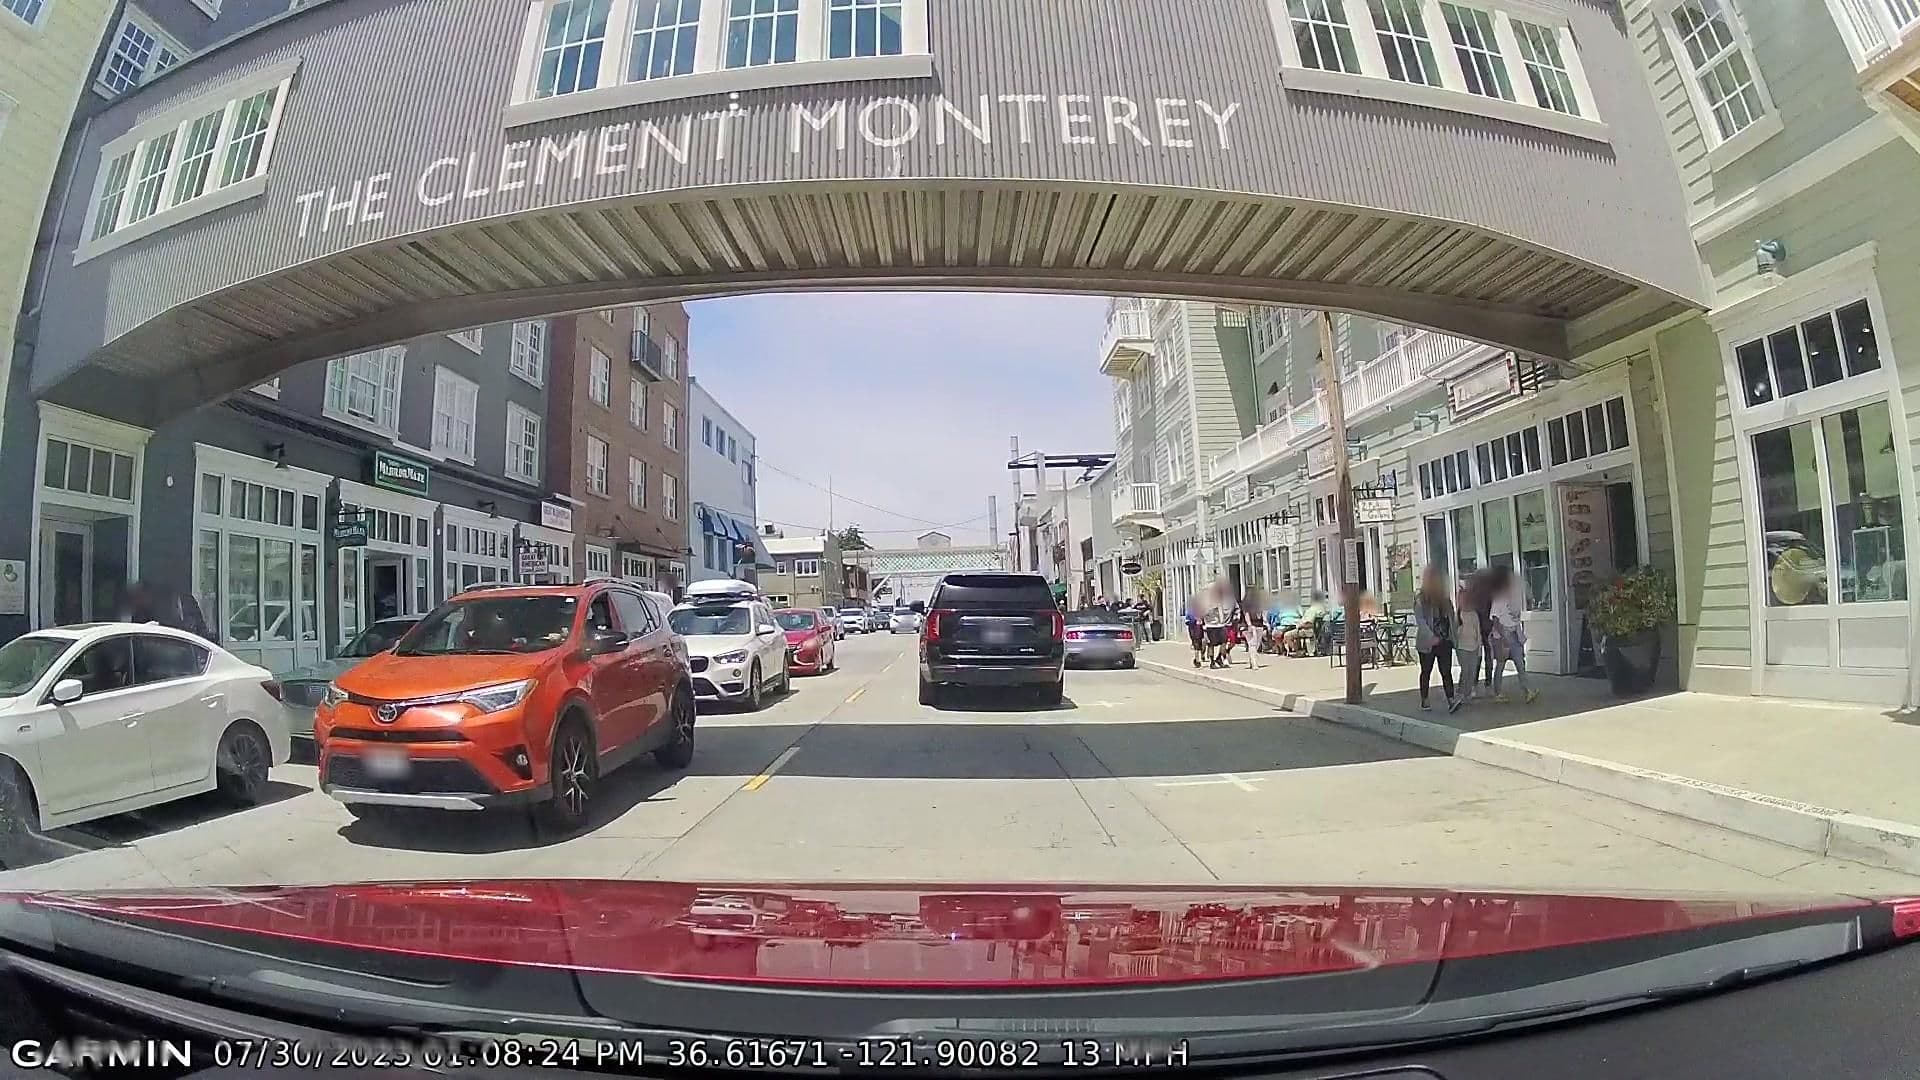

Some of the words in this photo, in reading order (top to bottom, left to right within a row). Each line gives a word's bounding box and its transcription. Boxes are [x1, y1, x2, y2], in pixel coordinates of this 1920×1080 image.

[295, 171, 392, 237] THE
[417, 109, 748, 207] CLEMENT
[790, 94, 1241, 153] MONTEREY
